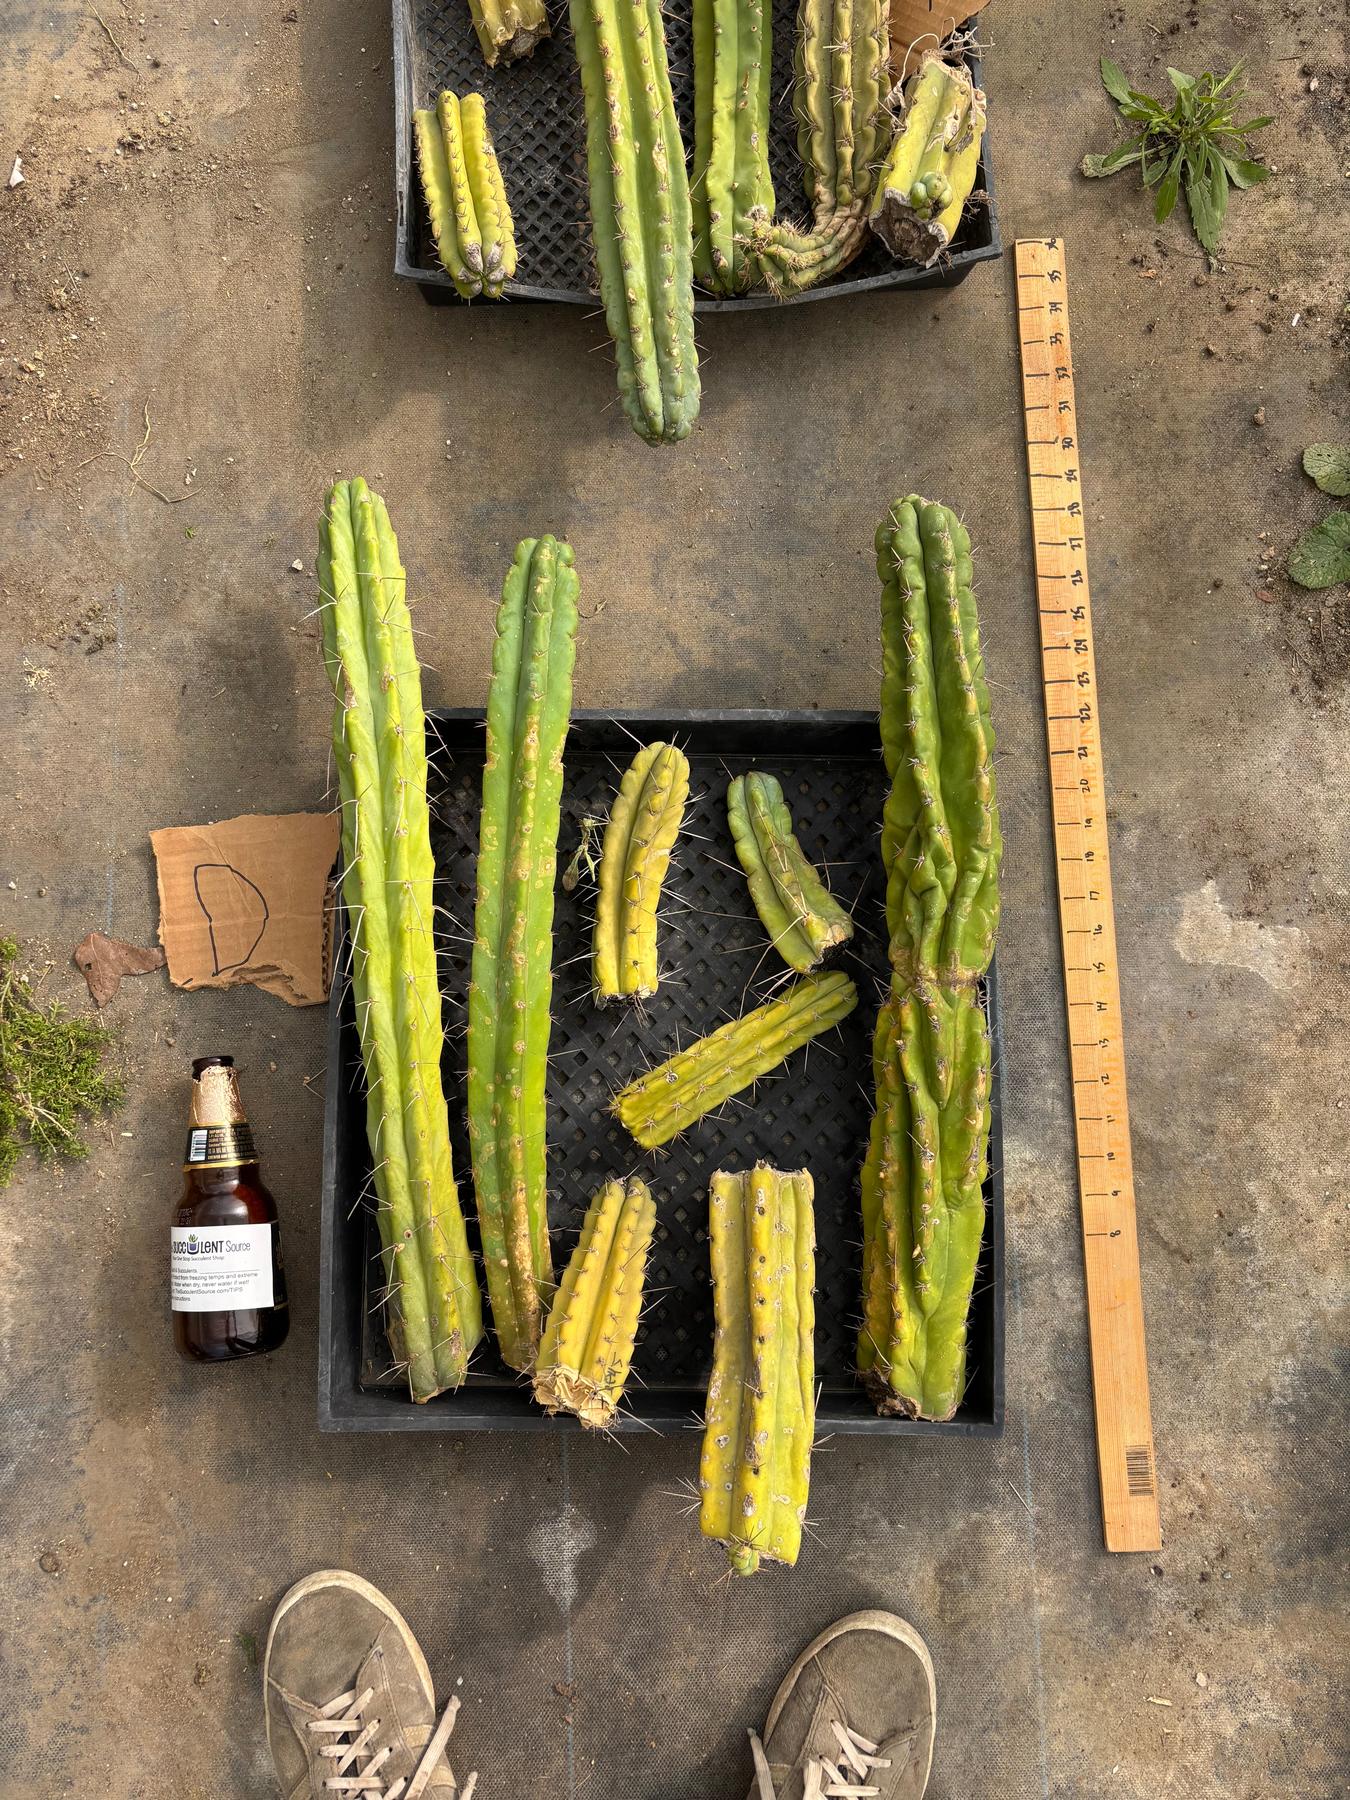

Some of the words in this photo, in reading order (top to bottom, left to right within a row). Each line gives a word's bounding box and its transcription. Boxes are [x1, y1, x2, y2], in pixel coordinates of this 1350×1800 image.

[1048, 270, 1062, 284] 35
[1048, 302, 1062, 314] 34
[1055, 366, 1070, 380] 32
[1058, 400, 1072, 414] 31
[1062, 436, 1074, 450] 30
[1067, 502, 1082, 518] 28
[1068, 537, 1084, 551] 27
[1070, 569, 1084, 586] 26
[1070, 606, 1086, 620] 25
[1074, 638, 1088, 654] 24
[1076, 670, 1090, 688] 23
[1078, 702, 1092, 724] 22
[1078, 746, 1088, 760] 21
[1080, 778, 1090, 794] 20
[1084, 817, 1093, 829] 19
[1084, 850, 1094, 862] 18
[1090, 890, 1100, 900] 17
[193, 863, 270, 978] D
[1092, 924, 1102, 936] 16
[1092, 962, 1106, 973] 15
[1096, 1001, 1108, 1012] 14
[1098, 1038, 1110, 1048] 13
[1100, 1072, 1110, 1086] 12
[1106, 1152, 1116, 1160] 10
[1110, 1229, 1121, 1238] 8
[225, 1240, 251, 1253] Source
